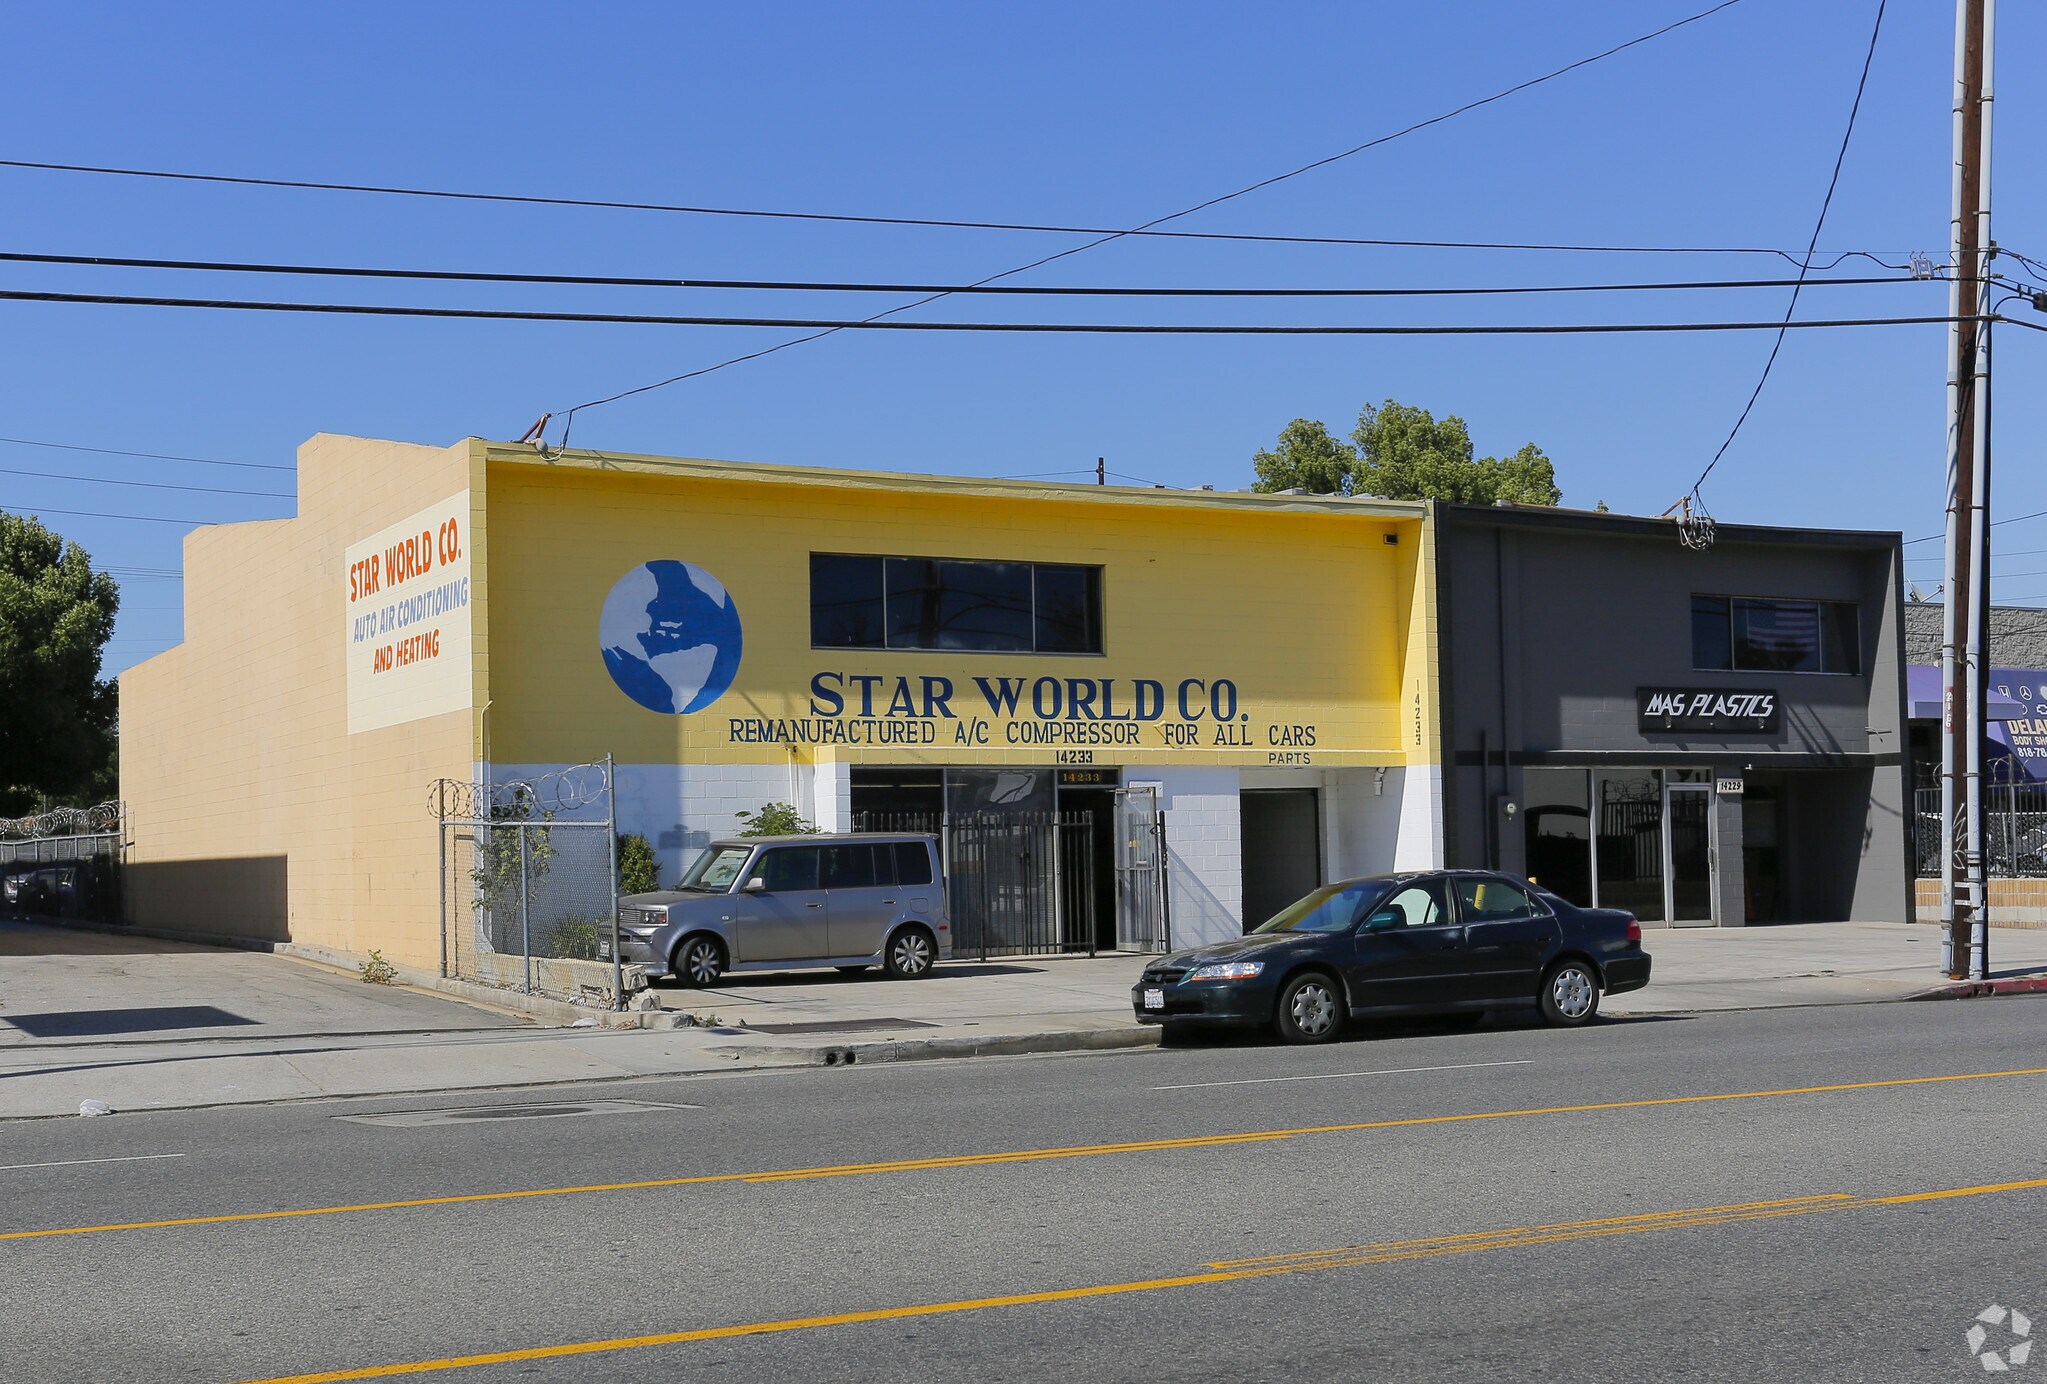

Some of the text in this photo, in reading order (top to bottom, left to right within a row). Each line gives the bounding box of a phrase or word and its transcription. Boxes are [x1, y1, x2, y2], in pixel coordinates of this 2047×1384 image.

[350, 517, 462, 602] STAR WORLD CO.
[354, 576, 468, 643] AUTO AIR CONDITIONING
[373, 628, 439, 674] AND HEATING
[810, 672, 1249, 722] STAR WORLD CO.
[1644, 693, 1774, 717] MAS PLASTICS
[729, 717, 1316, 746] REMANUFACTURED A/C COMPRESSOR FOR ALL CARS
[2012, 736, 2032, 745] BODY
[1056, 750, 1093, 763] 14233
[1268, 752, 1311, 764] PARTS
[1063, 773, 1100, 782] 14233
[1721, 781, 1741, 790] 14229
